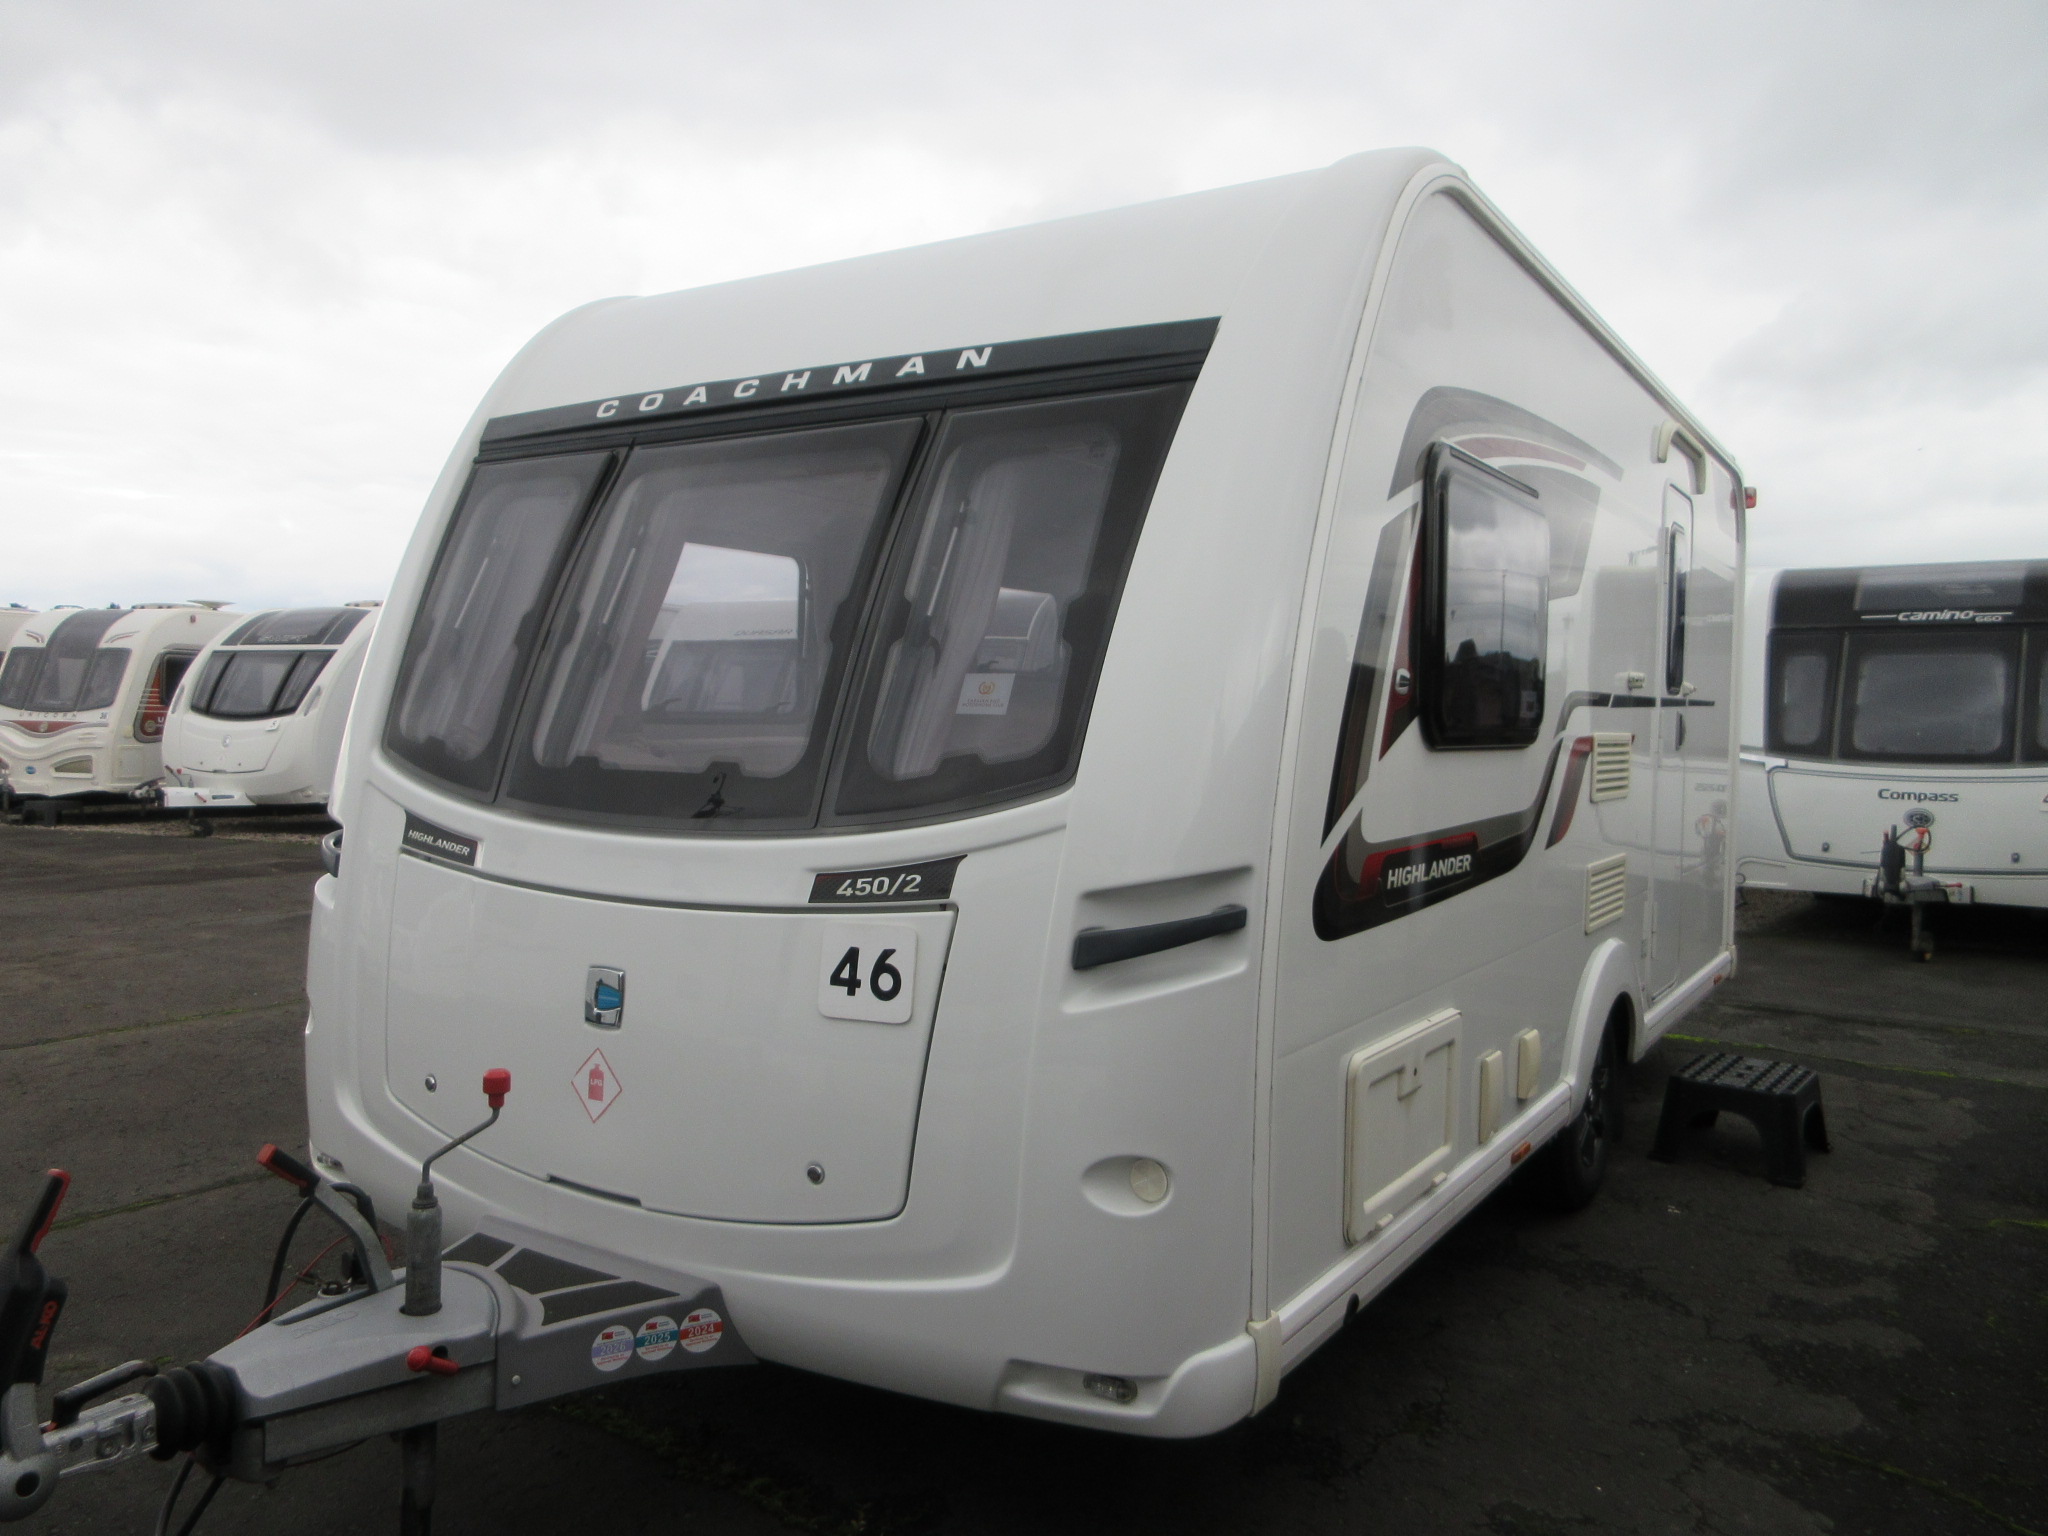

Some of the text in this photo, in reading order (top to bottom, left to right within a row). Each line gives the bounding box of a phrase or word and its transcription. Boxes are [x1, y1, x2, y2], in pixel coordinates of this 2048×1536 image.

[596, 346, 992, 418] COACHMAN
[1898, 609, 1975, 622] camino
[1877, 789, 1960, 803] Compass
[407, 829, 471, 856] HIGHLANDER
[1386, 854, 1472, 890] HIGHLANDER
[836, 873, 922, 897] 450/2
[829, 946, 902, 1001] 46
[643, 1332, 671, 1346] 2025
[688, 1323, 715, 1338] 2024
